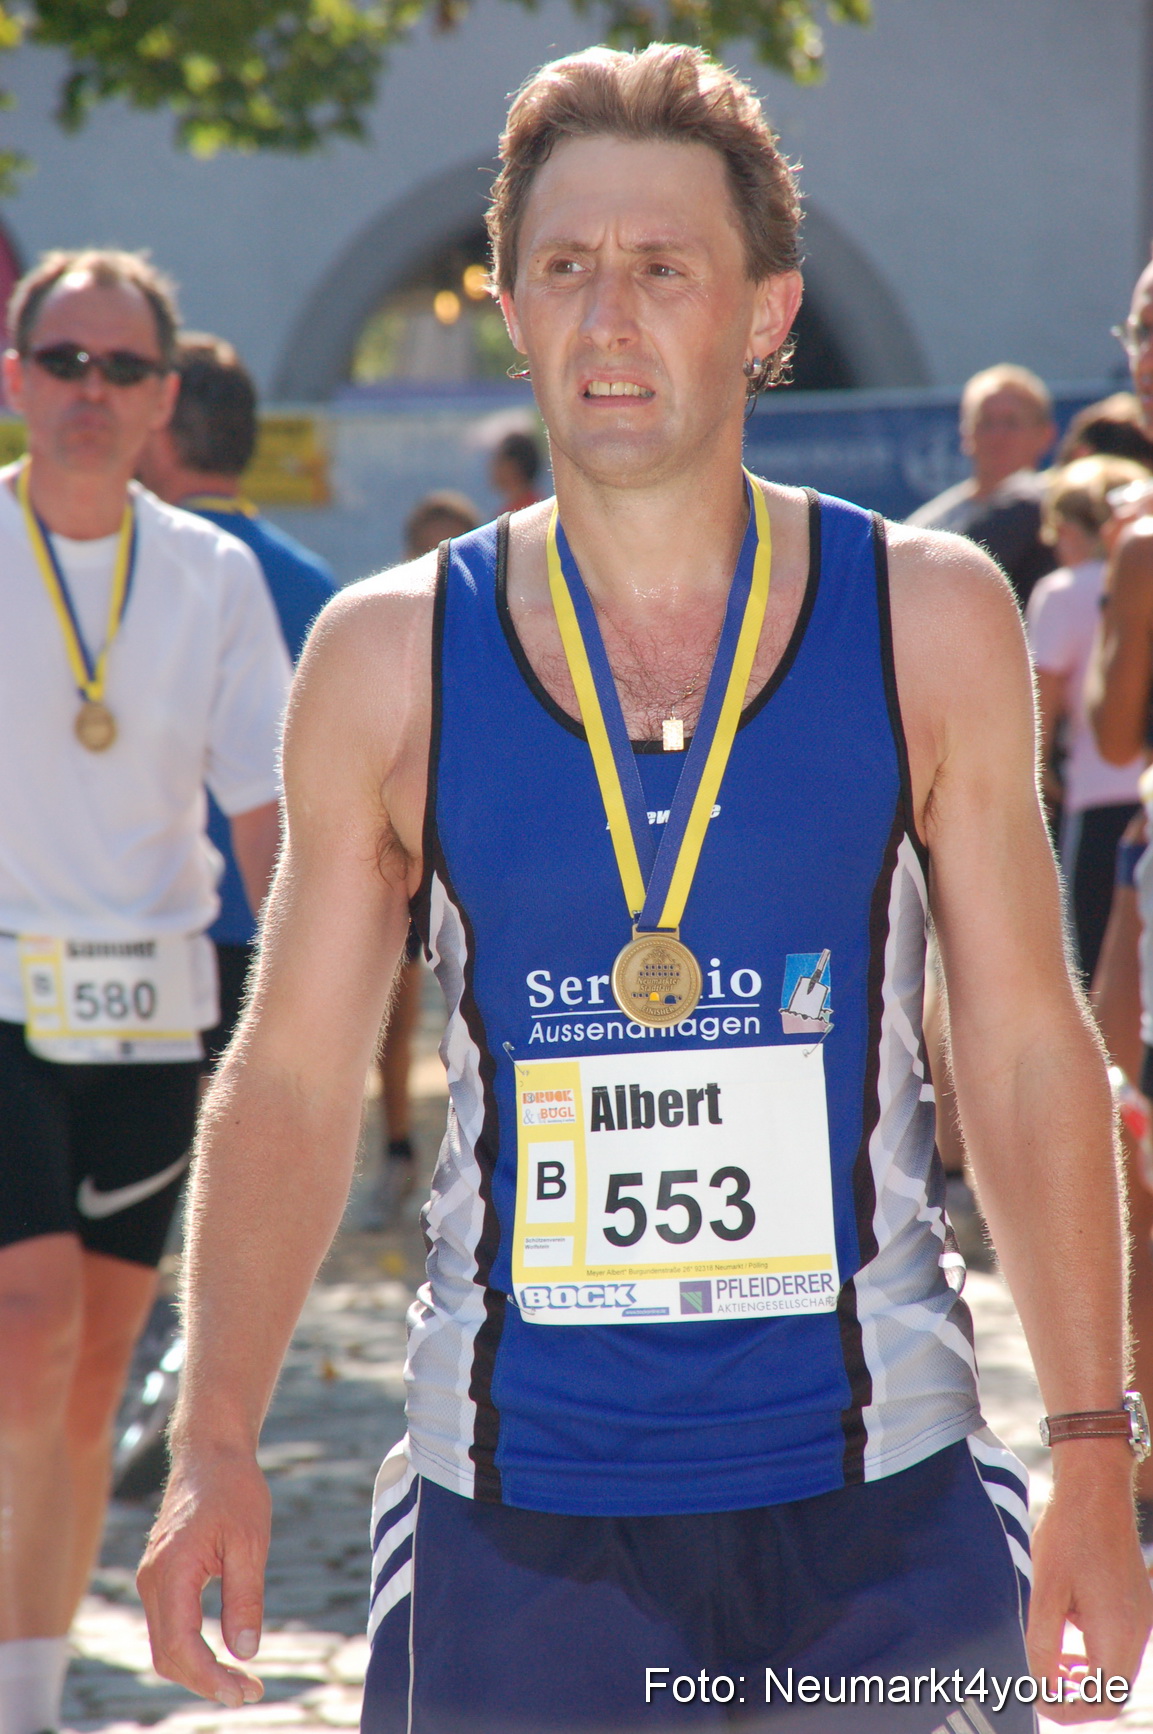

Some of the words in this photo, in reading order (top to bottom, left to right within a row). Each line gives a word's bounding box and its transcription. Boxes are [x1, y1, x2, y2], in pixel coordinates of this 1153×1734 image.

[75, 980, 156, 1020] 580
[591, 1083, 722, 1132] Albert
[536, 1161, 567, 1201] B
[602, 1166, 756, 1247] 553
[586, 1269, 605, 1277] Meyer
[714, 1263, 743, 1271] Neumarkt
[716, 1273, 834, 1299] PFLEIDERER
[520, 1284, 637, 1309] BOCK
